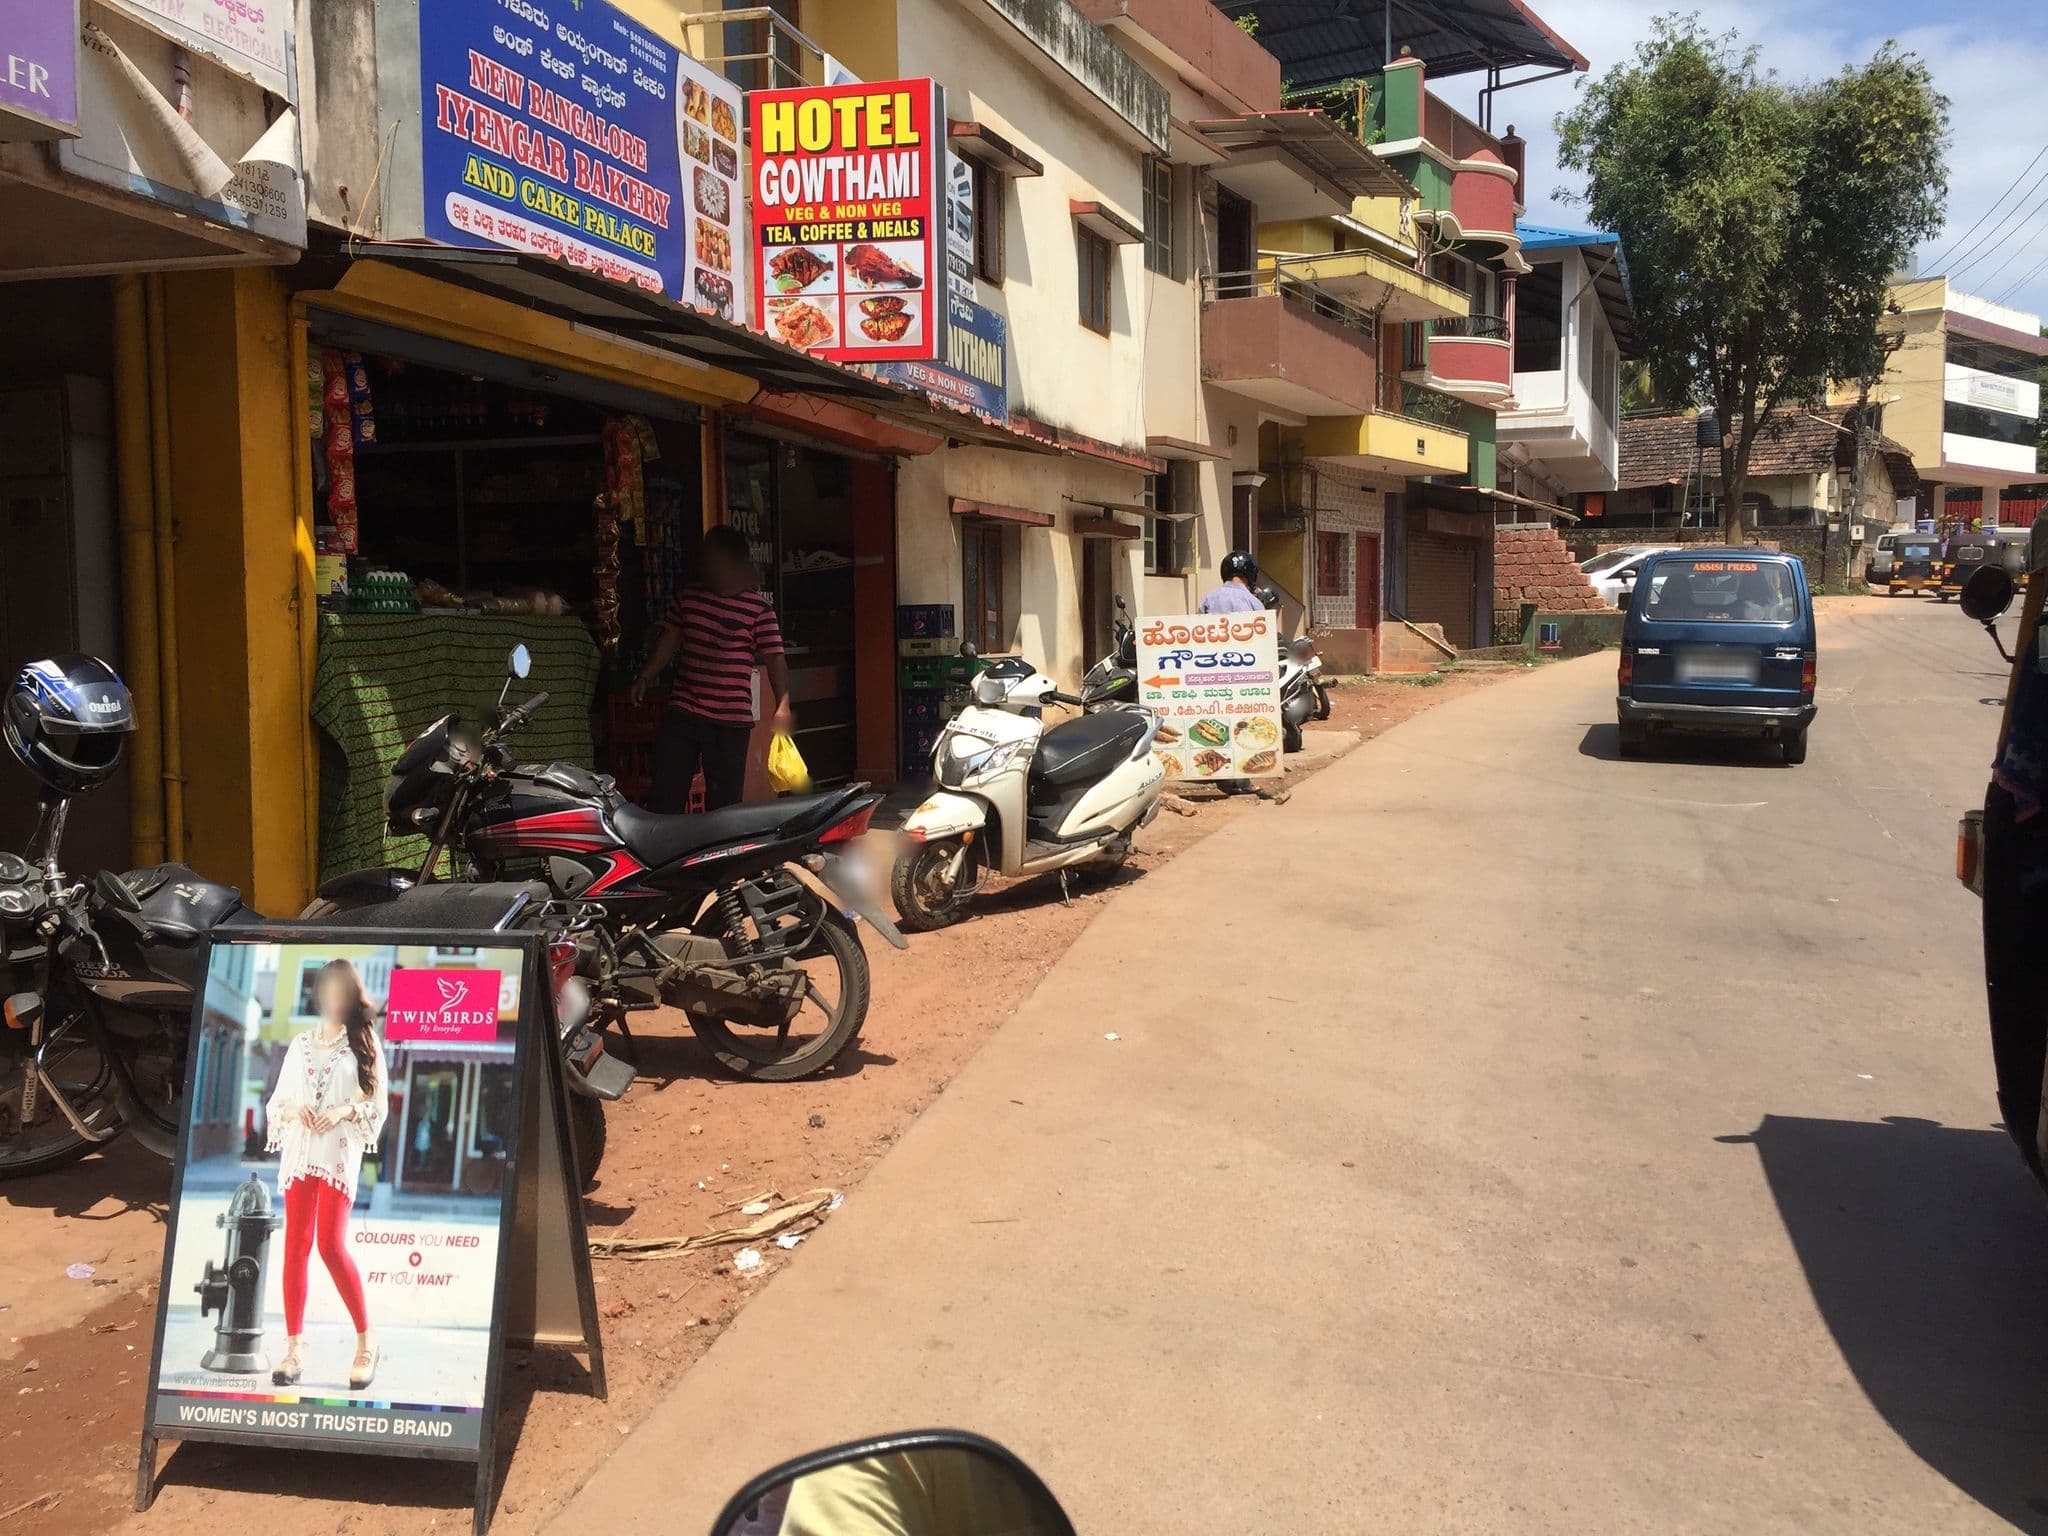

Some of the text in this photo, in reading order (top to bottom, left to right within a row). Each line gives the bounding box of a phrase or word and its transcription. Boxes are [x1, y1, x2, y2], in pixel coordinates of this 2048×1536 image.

[0, 54, 51, 98] ER
[469, 49, 647, 173] NEW BANGALORE
[761, 92, 920, 154] HOTEL
[436, 84, 671, 229] IYENGAR BAKERY
[760, 151, 920, 206] GOWTHAMI
[463, 153, 657, 260] AND CAKE PALACE
[785, 202, 902, 221] VEG & NON VEG
[766, 219, 920, 245] TEA, COFFEE & MEALS
[906, 363, 976, 398] VEG & NON VEG
[1727, 562, 1758, 571] PRESS
[391, 1011, 494, 1024] TWIN BIRDS
[420, 1025, 463, 1034] Fly Everyday
[355, 1232, 481, 1248] COLOURS YOU NEED
[368, 1271, 453, 1287] FIT YOU WANT
[180, 1405, 453, 1438] WOMEN'S MOST TRUSTED BRAND
